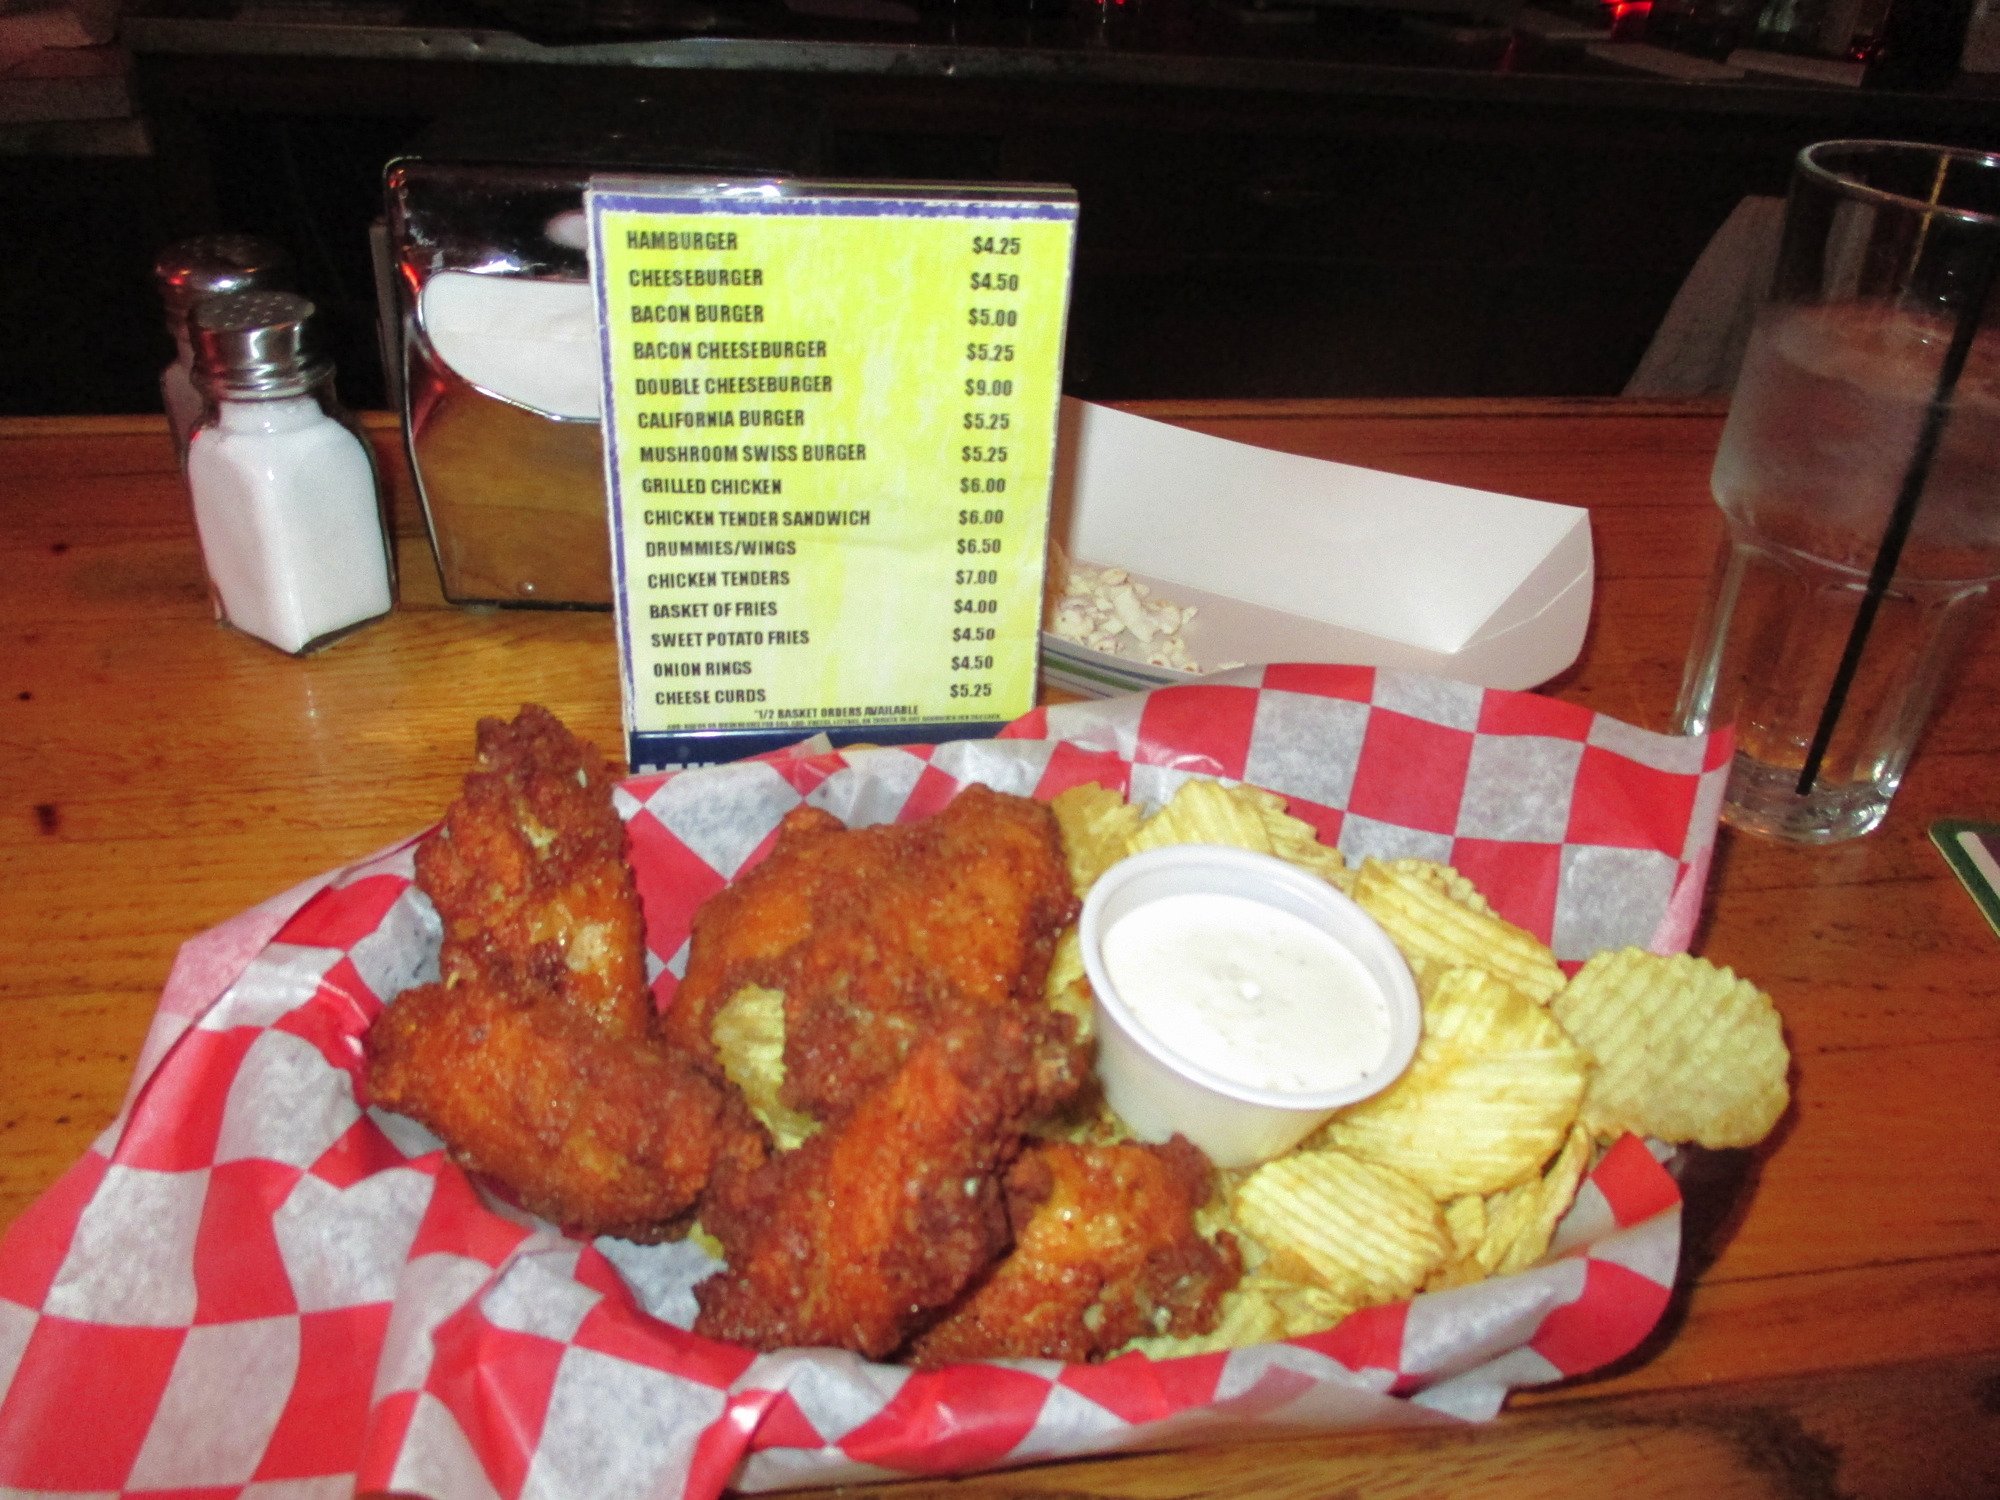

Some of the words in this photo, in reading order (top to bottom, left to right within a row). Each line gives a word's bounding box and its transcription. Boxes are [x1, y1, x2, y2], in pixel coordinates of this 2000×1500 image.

[628, 232, 737, 250] HAMBURGER
[973, 237, 1020, 254] $4.25
[630, 269, 762, 286] CHEESEBURGER
[971, 273, 1018, 290] $4.50
[632, 305, 690, 322] BACON
[696, 305, 763, 322] BURGER
[969, 309, 1017, 326] $5.00
[634, 342, 691, 359] BACON
[698, 341, 826, 359] CHEESEBURGER
[967, 343, 1014, 361] $5.25
[636, 379, 699, 395] DOUBLE
[705, 376, 832, 393] CHEESEBURGER
[965, 379, 1012, 396] $9.00
[638, 412, 734, 428] CALIFORNIA
[740, 410, 803, 426] BURGER
[964, 413, 1009, 429] $5.25
[640, 446, 737, 462] MUSHROOM
[743, 445, 797, 461] SWISS
[803, 444, 865, 461] BURGER
[962, 446, 1007, 462] $5.25
[642, 479, 705, 493] GRILLED
[712, 480, 781, 494] CHICKEN
[961, 478, 1006, 493] $6.00
[644, 511, 713, 525] CHICKEN
[719, 512, 778, 526] TENDER
[783, 511, 869, 526] SANDWICH
[959, 510, 1003, 525] $6.00
[646, 541, 796, 556] DRUMMIES/WINGS
[958, 539, 1001, 554] $6.50
[648, 573, 716, 588] CHICKEN
[722, 571, 789, 586] TENDERS
[956, 570, 997, 584] $7.00
[650, 604, 708, 618] BASKET
[714, 603, 731, 617] OF
[736, 602, 777, 616] FRIES
[955, 600, 997, 613] $4.00
[652, 633, 702, 647] SWEET
[707, 632, 763, 645] POTATO
[769, 631, 809, 644] FRIES
[953, 628, 995, 641] $4.50
[654, 663, 700, 676] ONION
[706, 662, 751, 675] RINGS
[952, 656, 993, 670] $4.50
[656, 691, 709, 704] CHEESE
[715, 689, 765, 703] CURDS
[951, 684, 991, 698] $5.25
[777, 708, 818, 719] BASKET
[821, 706, 862, 718] ORDERS
[865, 705, 919, 716] AVAILABLE
